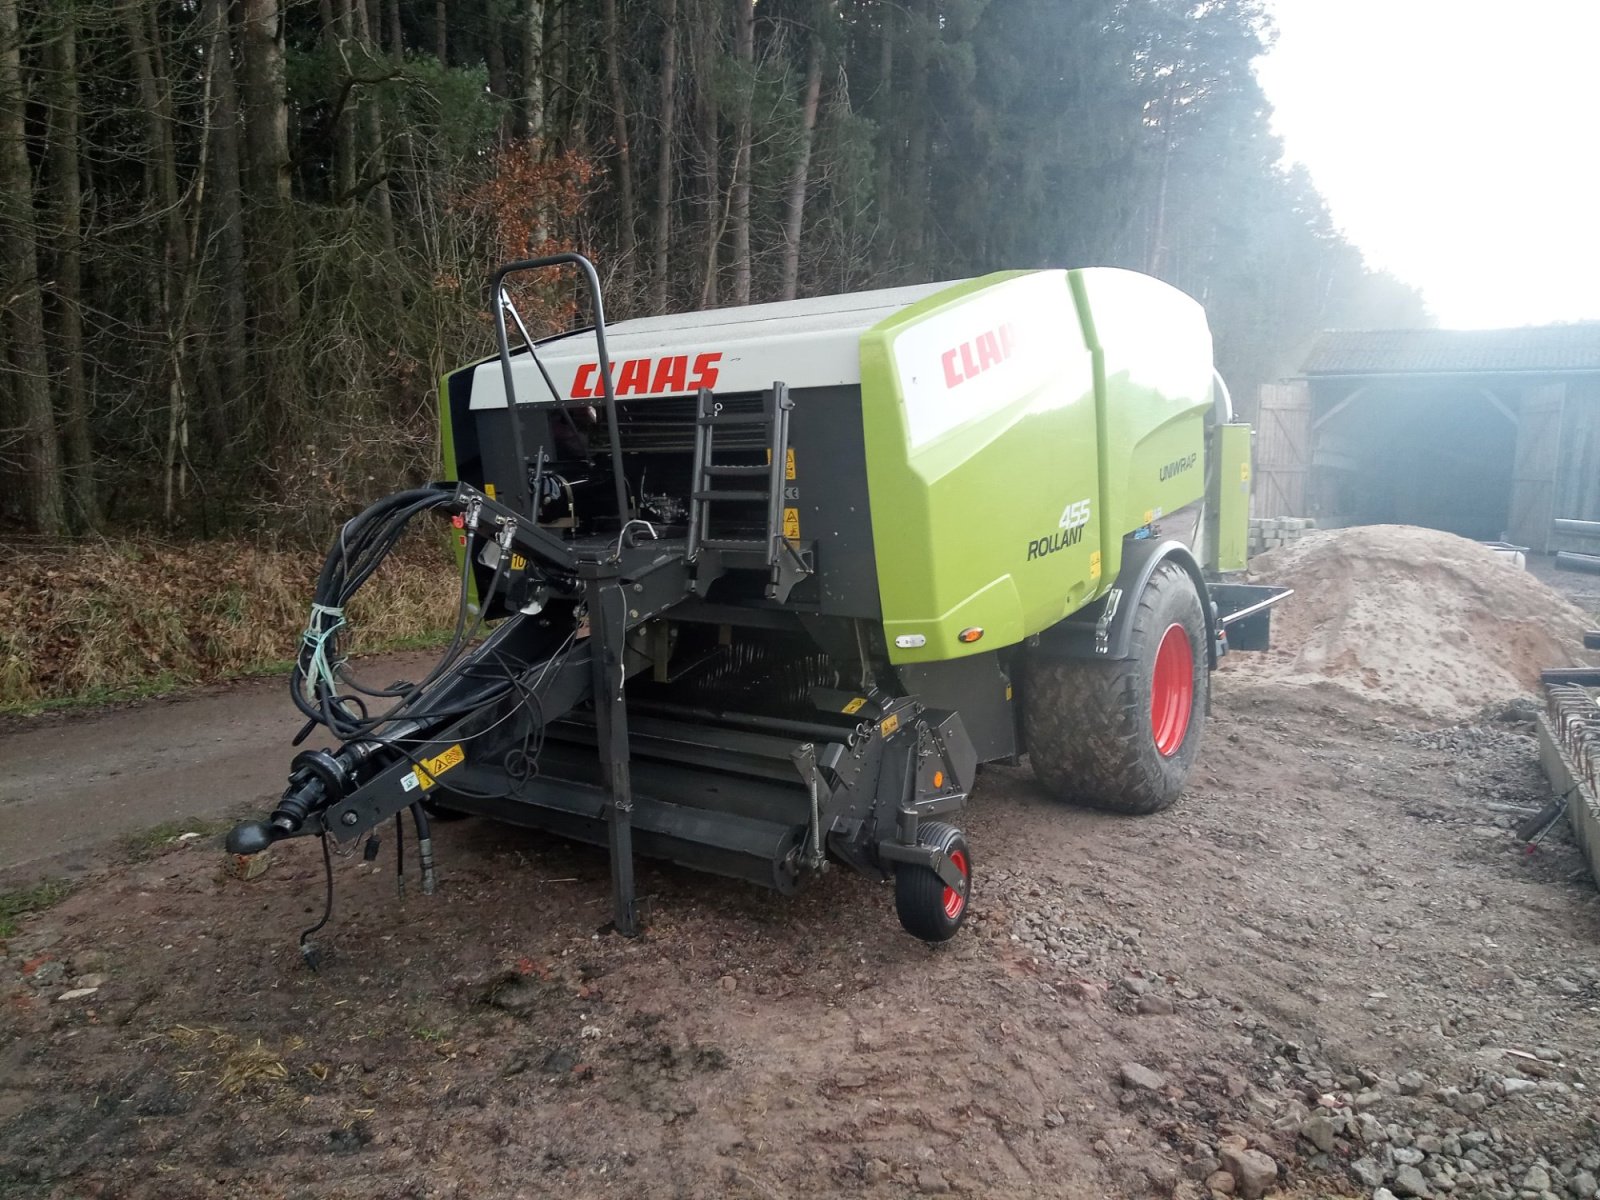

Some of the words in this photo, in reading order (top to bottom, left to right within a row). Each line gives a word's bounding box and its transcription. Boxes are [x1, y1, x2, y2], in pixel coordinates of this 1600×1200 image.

[570, 352, 723, 398] CLAAS
[1159, 452, 1197, 482] UNIWRAP
[1059, 498, 1091, 529] 455
[1026, 523, 1085, 561] ROLLANT
